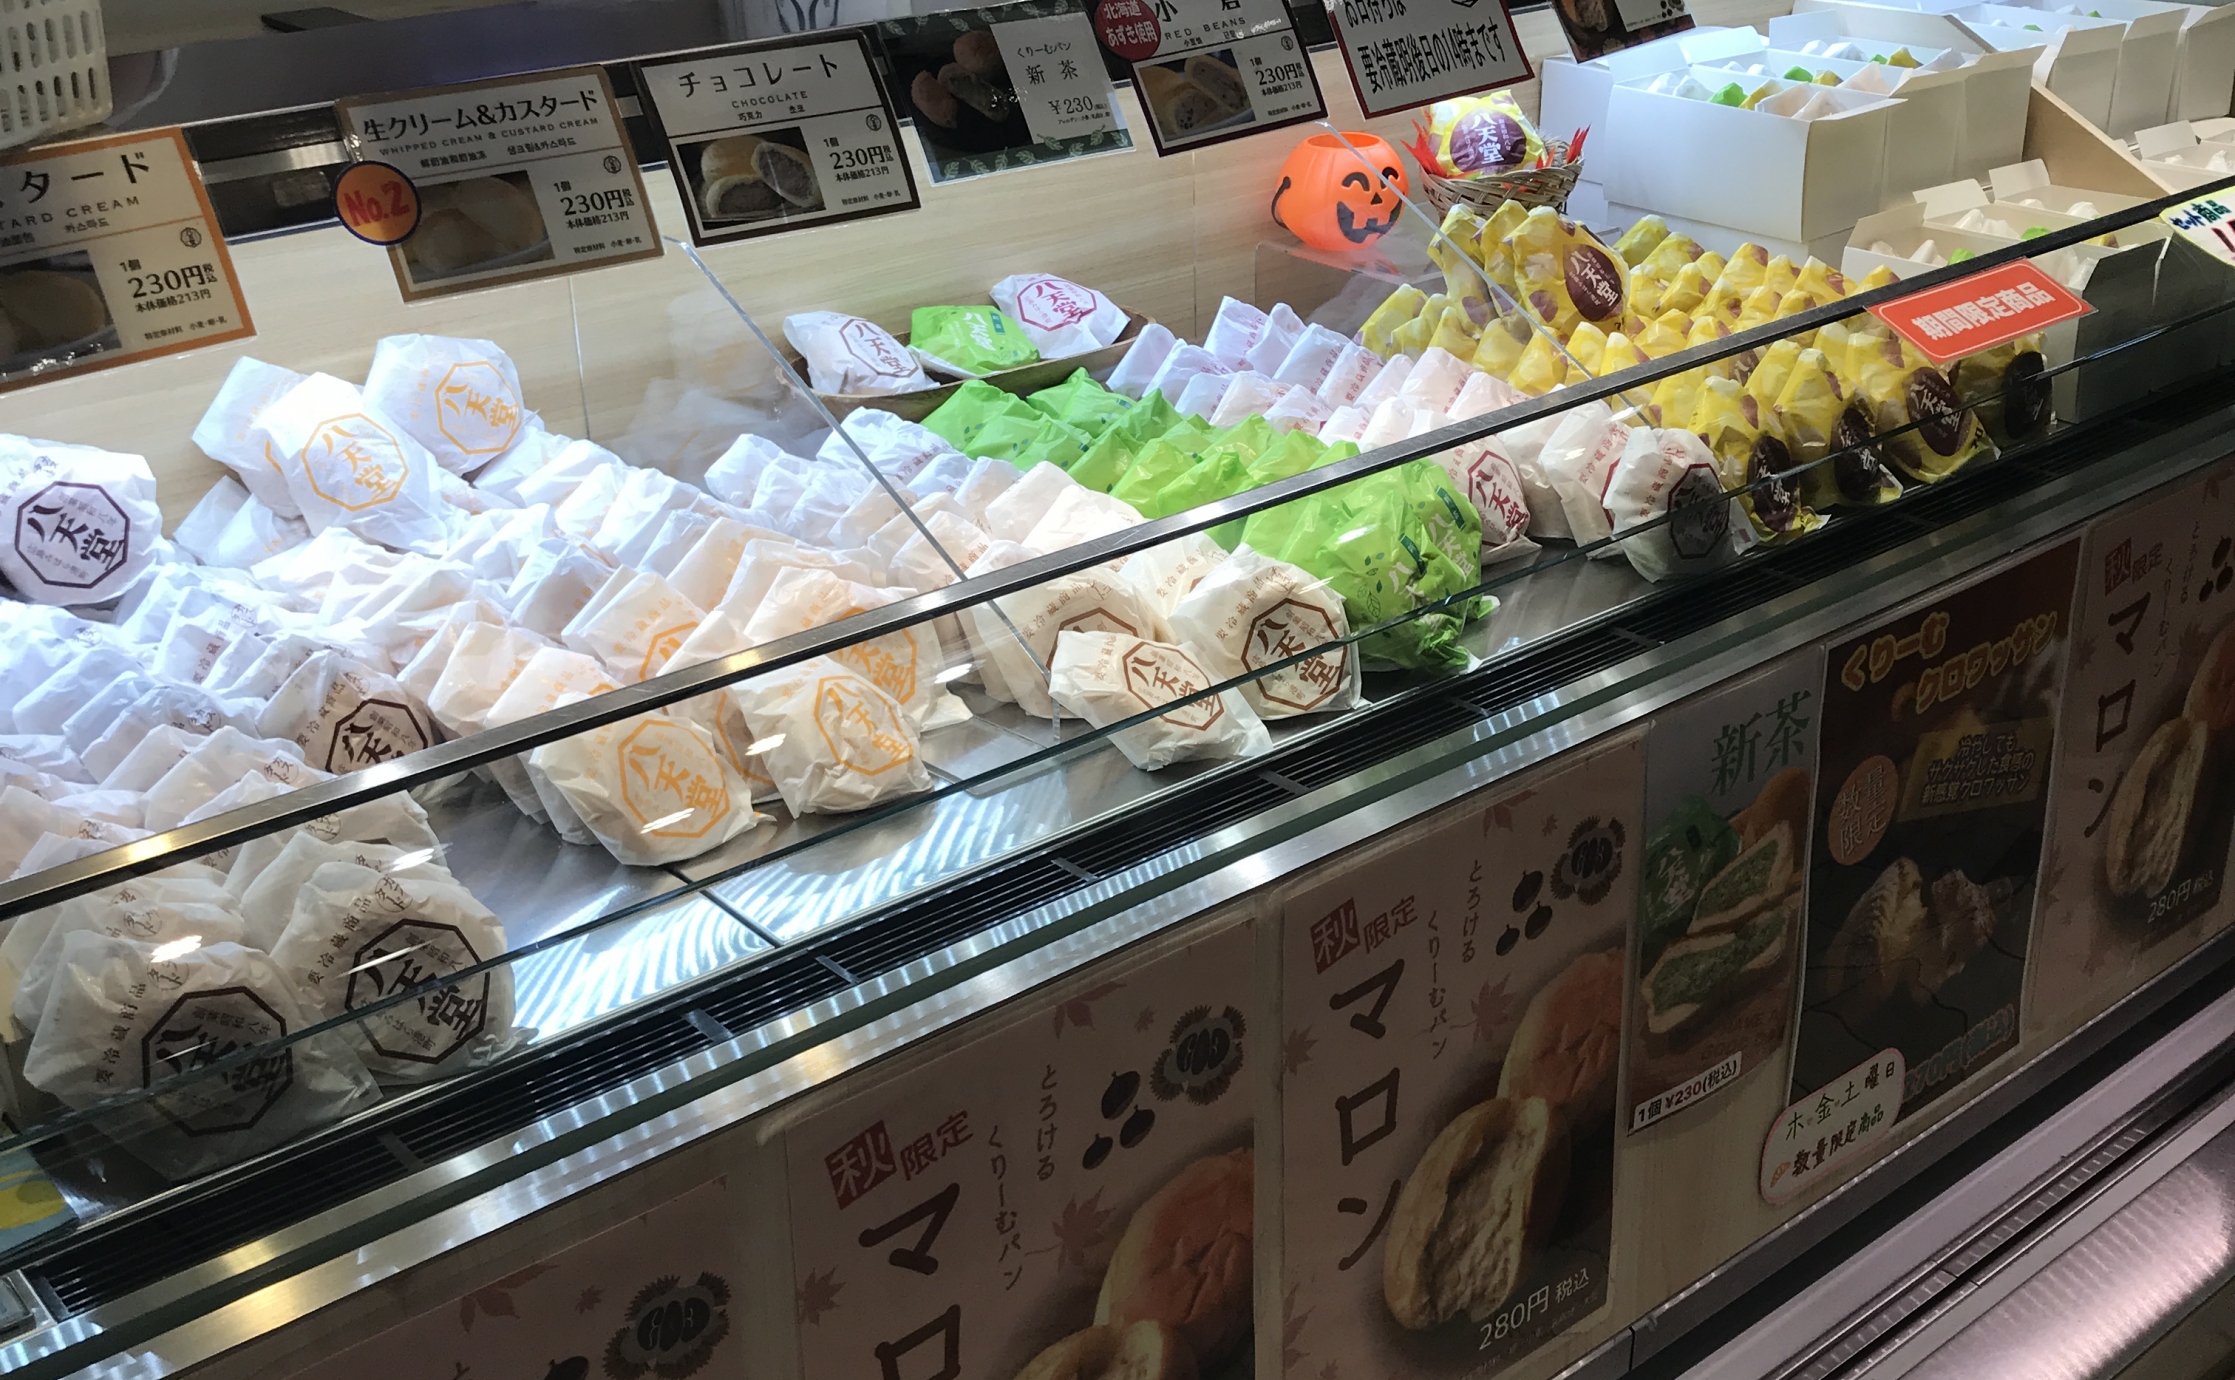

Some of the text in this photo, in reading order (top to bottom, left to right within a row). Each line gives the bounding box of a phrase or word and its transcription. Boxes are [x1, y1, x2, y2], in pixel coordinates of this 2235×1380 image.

[1104, 1, 1141, 20] 北海道
[1106, 21, 1160, 48] あずき使用
[1164, 17, 1246, 41] RED BEANS
[679, 54, 838, 98] チョコレート
[1017, 41, 1071, 58] くりーむパン
[363, 90, 597, 144] 生クリーム&カスタード
[732, 91, 808, 109] CHOCOLATE
[1048, 95, 1093, 115] ¥230
[380, 116, 598, 156] WHIPPED CREAM & CUSTARD CREAM
[829, 145, 885, 170] 230円
[1470, 110, 1505, 165] 八天堂
[0, 152, 150, 209] タード
[560, 189, 626, 217] 230円
[835, 166, 890, 183] 本体価格213円
[66, 196, 140, 219] CREAM
[343, 181, 411, 227] No.2
[566, 211, 629, 230] 本体価格213円
[127, 263, 206, 299] 230円
[135, 289, 212, 314] 本体価格213円
[1035, 281, 1087, 324] 八天堂
[1570, 250, 1620, 307] 八天堂
[1911, 281, 2057, 342] 期間限定商品
[854, 321, 911, 376] 八天堂
[443, 383, 520, 434] 八天堂
[322, 425, 403, 501] 八天堂
[1476, 466, 1530, 531] 八天堂
[27, 504, 125, 571] 八天堂
[1285, 609, 1330, 646] 創業昭和八
[1842, 612, 1950, 693] くりーむ
[840, 641, 918, 698] 天堂
[1256, 618, 1341, 697] 八天堂
[1916, 611, 2058, 715] クロワッサン
[1131, 656, 1216, 717] 八天堂
[2084, 589, 2152, 839] マロン
[342, 722, 406, 764] 八天
[829, 681, 912, 756] 八天堂
[1712, 690, 1812, 796] 新茶
[631, 744, 729, 813] 八天堂
[1460, 857, 1483, 964] とろける
[2148, 877, 2192, 923] 280円
[1309, 895, 1420, 975] 秋限定
[366, 946, 484, 1042] 八天堂
[1427, 909, 1448, 1061] くりーむパン
[1328, 958, 1406, 1272] マロン
[1637, 1057, 1739, 1125] 1個 ¥230(税込)
[1036, 1064, 1058, 1182] とろける
[1790, 1104, 1885, 1177] 数量限定商品
[824, 1110, 974, 1211] 秋限定
[989, 1124, 1023, 1291] くりーむパン
[1478, 1281, 1551, 1351] 280円
[1554, 1266, 1591, 1304] 税込
